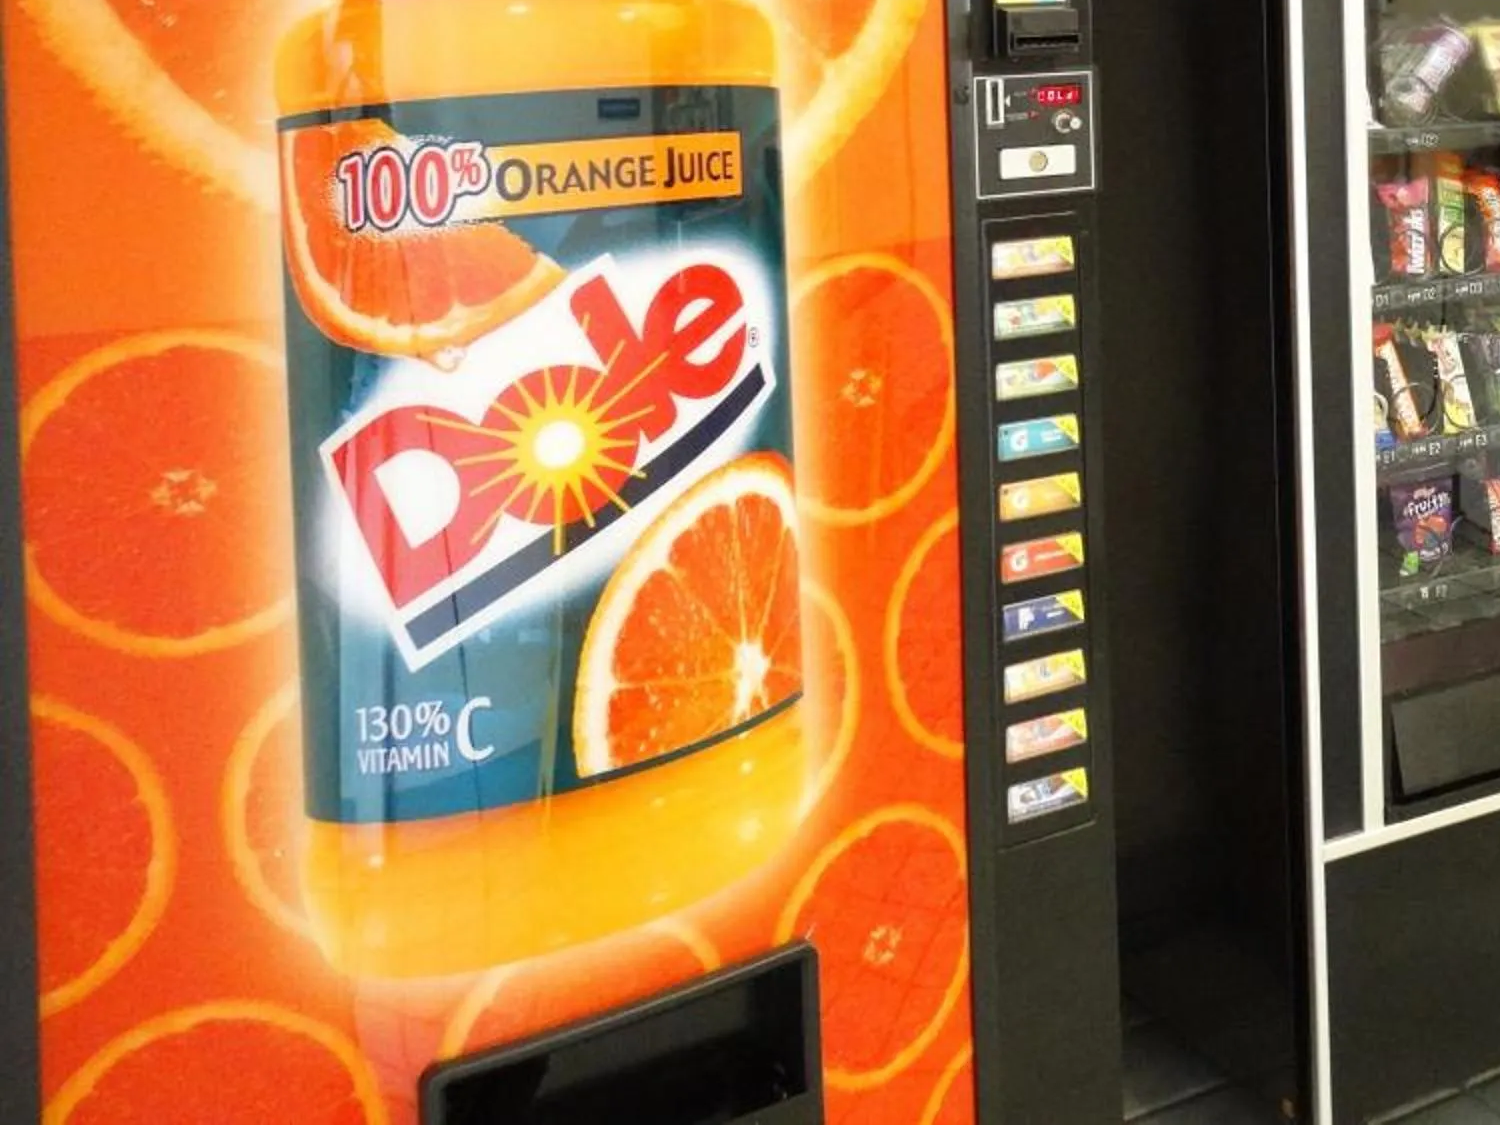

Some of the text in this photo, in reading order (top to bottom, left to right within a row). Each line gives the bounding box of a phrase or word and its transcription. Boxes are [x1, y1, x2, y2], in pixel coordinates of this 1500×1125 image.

[340, 142, 490, 231] 100%
[331, 263, 749, 611] Dole
[356, 695, 495, 763] 130% C
[357, 740, 450, 775] VITAMIN
